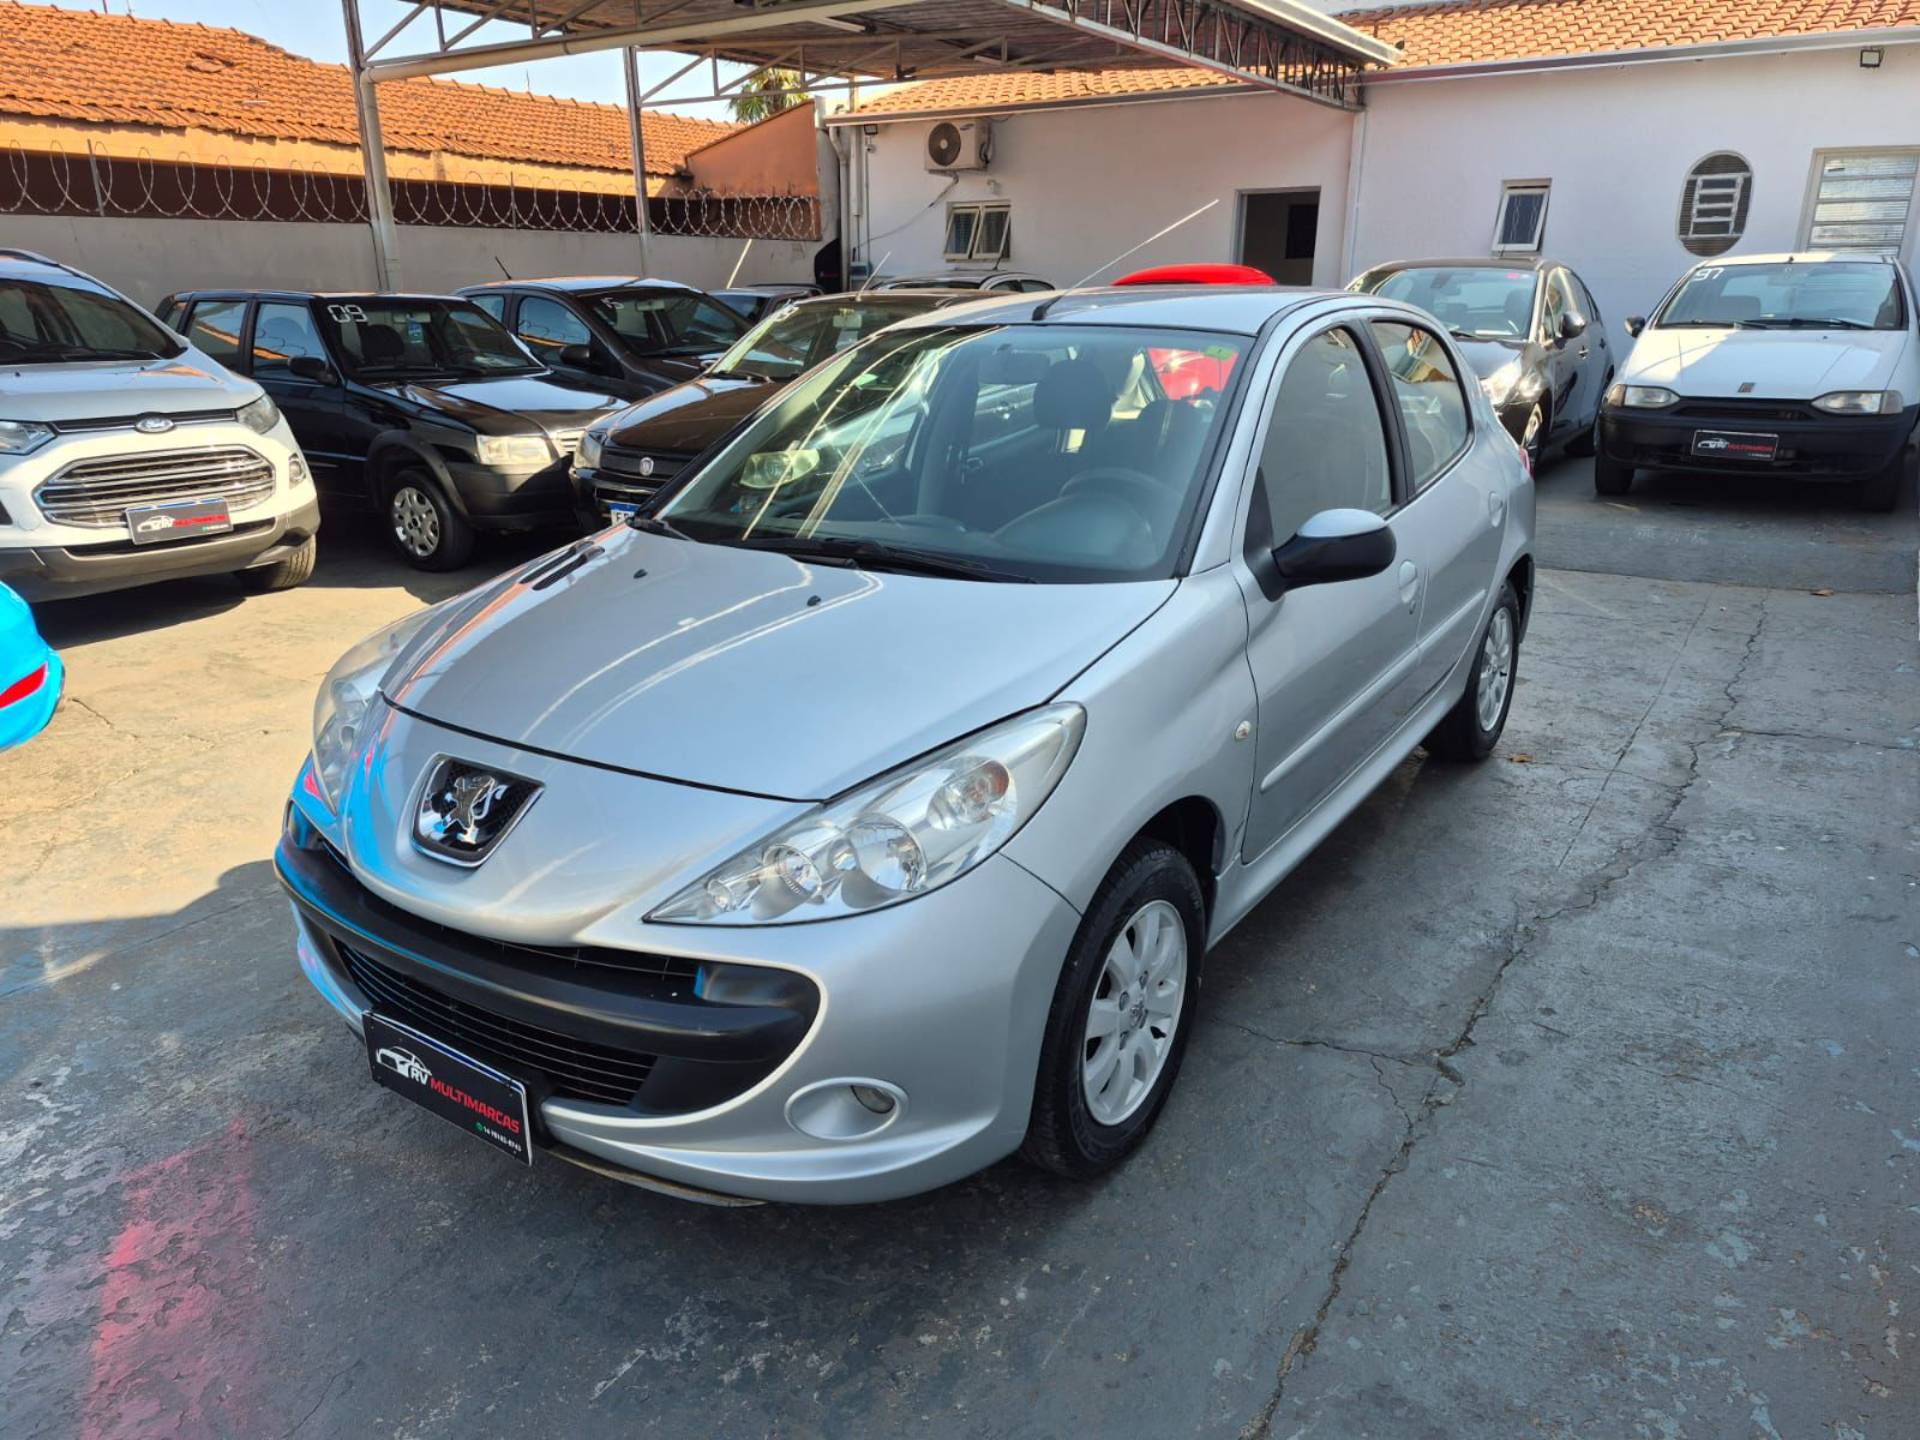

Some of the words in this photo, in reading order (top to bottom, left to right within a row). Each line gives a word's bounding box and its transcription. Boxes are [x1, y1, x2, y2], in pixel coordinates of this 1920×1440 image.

[1694, 267, 1725, 281] 97
[327, 304, 368, 323] 09
[430, 1077, 521, 1135] MULTIMARCAS
